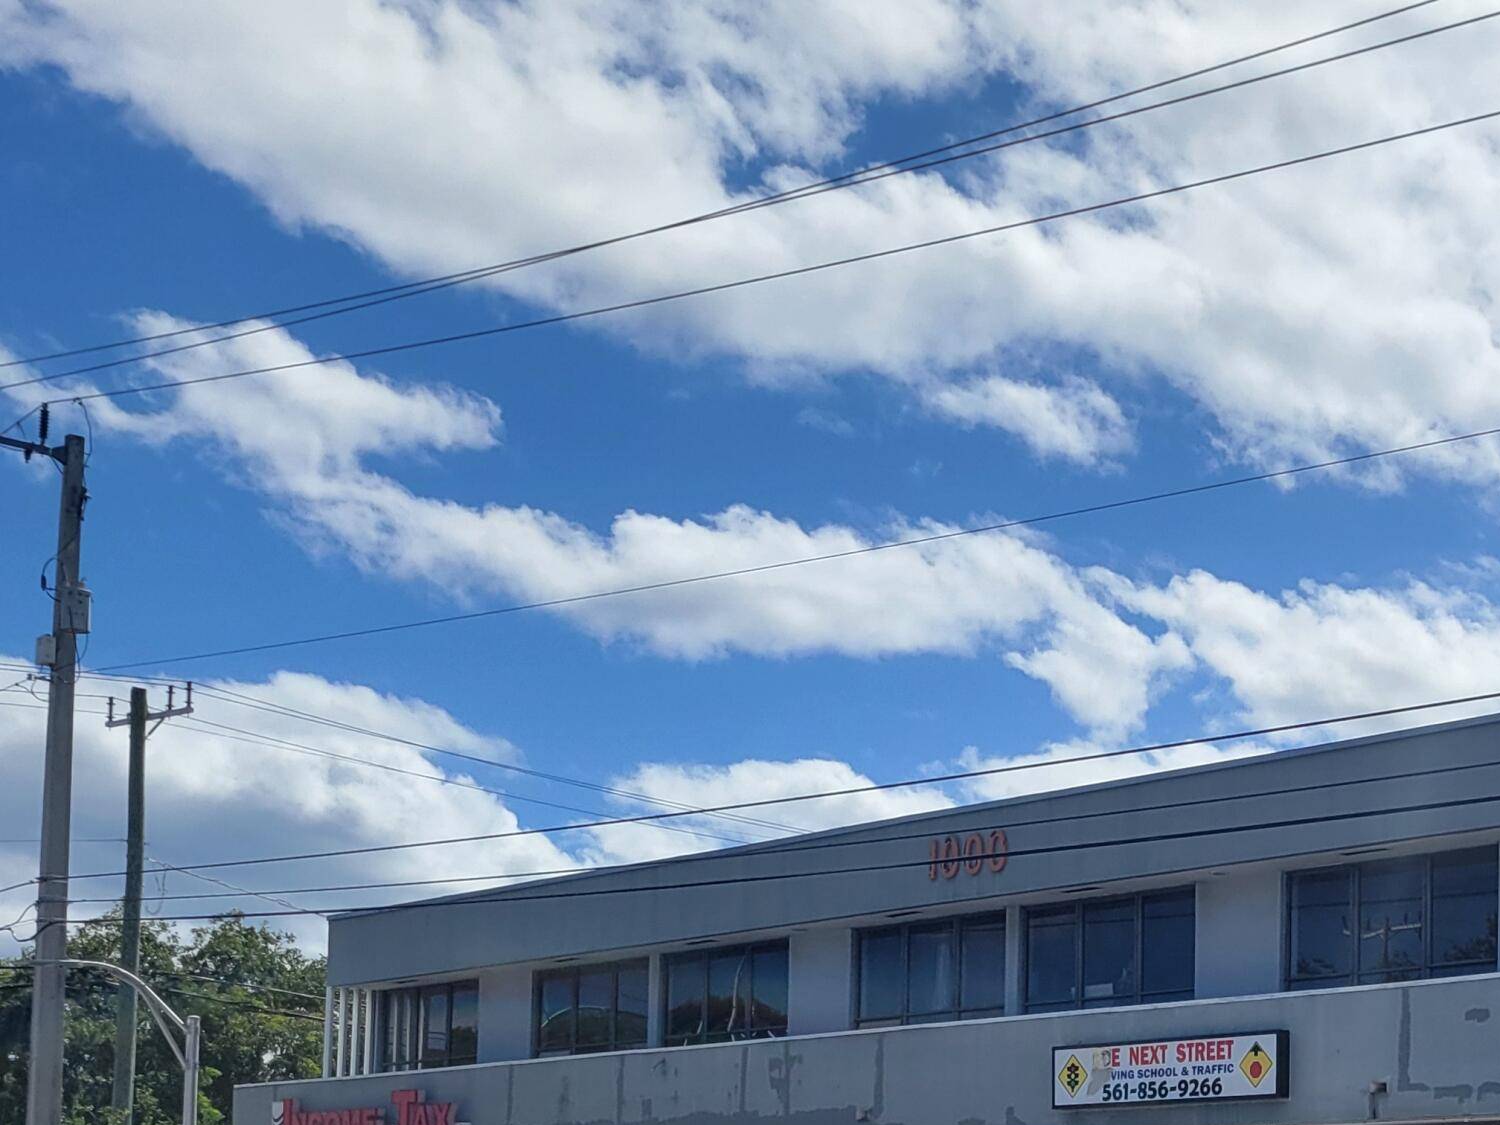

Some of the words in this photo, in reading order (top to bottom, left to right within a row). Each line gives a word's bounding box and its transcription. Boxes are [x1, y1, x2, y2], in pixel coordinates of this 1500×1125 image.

[928, 828, 1009, 881] 1000
[1129, 1046, 1168, 1067] NEXT
[1176, 1040, 1234, 1062] STREET
[1110, 1069, 1135, 1081] VING
[1137, 1067, 1177, 1079] SCHOOL
[1181, 1067, 1189, 1077] &
[1191, 1063, 1235, 1076] TRAFFIC
[1102, 1077, 1223, 1101] 561-856-9266
